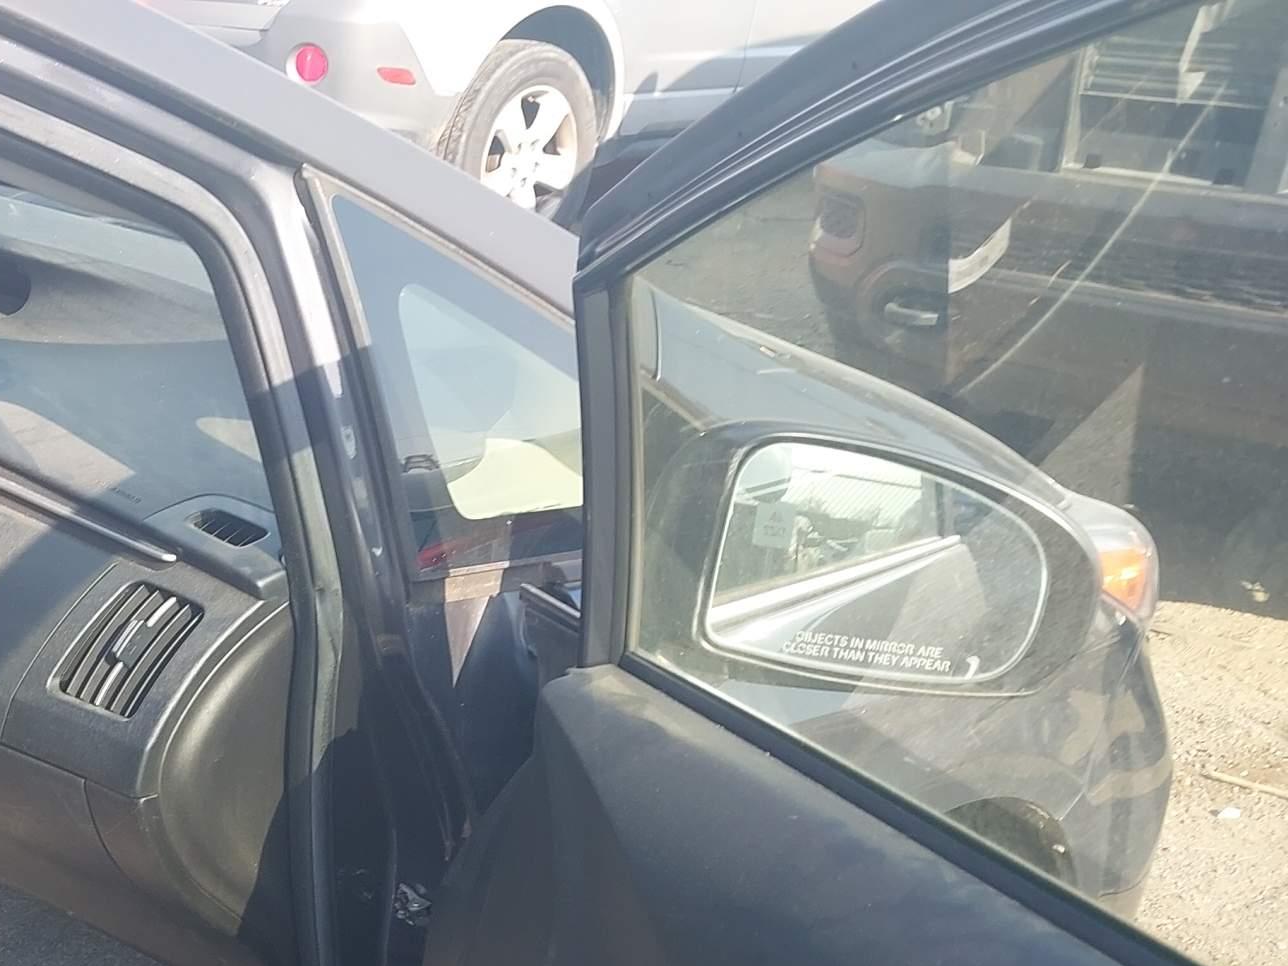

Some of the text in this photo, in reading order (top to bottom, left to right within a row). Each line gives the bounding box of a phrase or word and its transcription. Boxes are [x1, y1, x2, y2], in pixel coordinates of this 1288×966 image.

[783, 641, 951, 672] CLOSER THAN THEY APPEAR
[795, 631, 944, 658] OBJECTS IN MIRROR ARE
